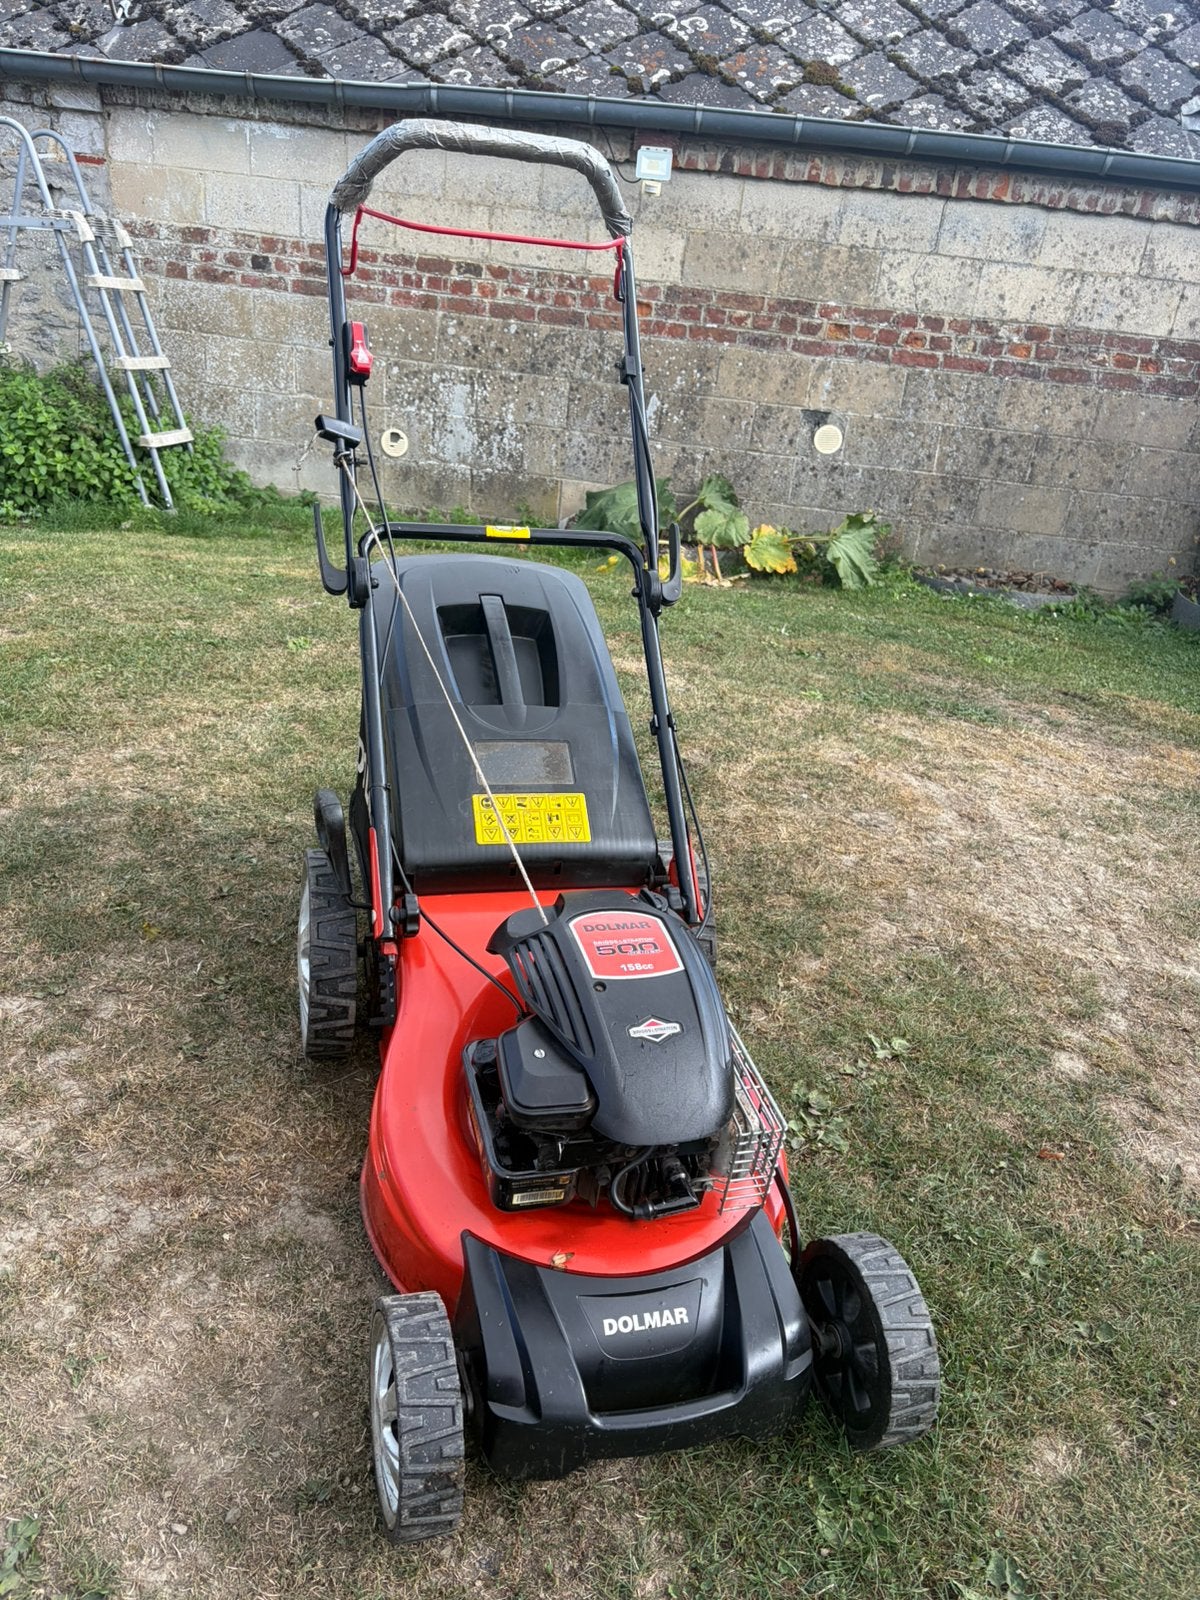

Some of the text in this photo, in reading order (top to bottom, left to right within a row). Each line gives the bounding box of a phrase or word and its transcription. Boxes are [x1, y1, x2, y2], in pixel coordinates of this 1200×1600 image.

[583, 921, 651, 932] DOLMAR
[596, 942, 659, 956] 500
[620, 963, 654, 972] 158cc
[603, 1307, 689, 1336] DOLMAR
